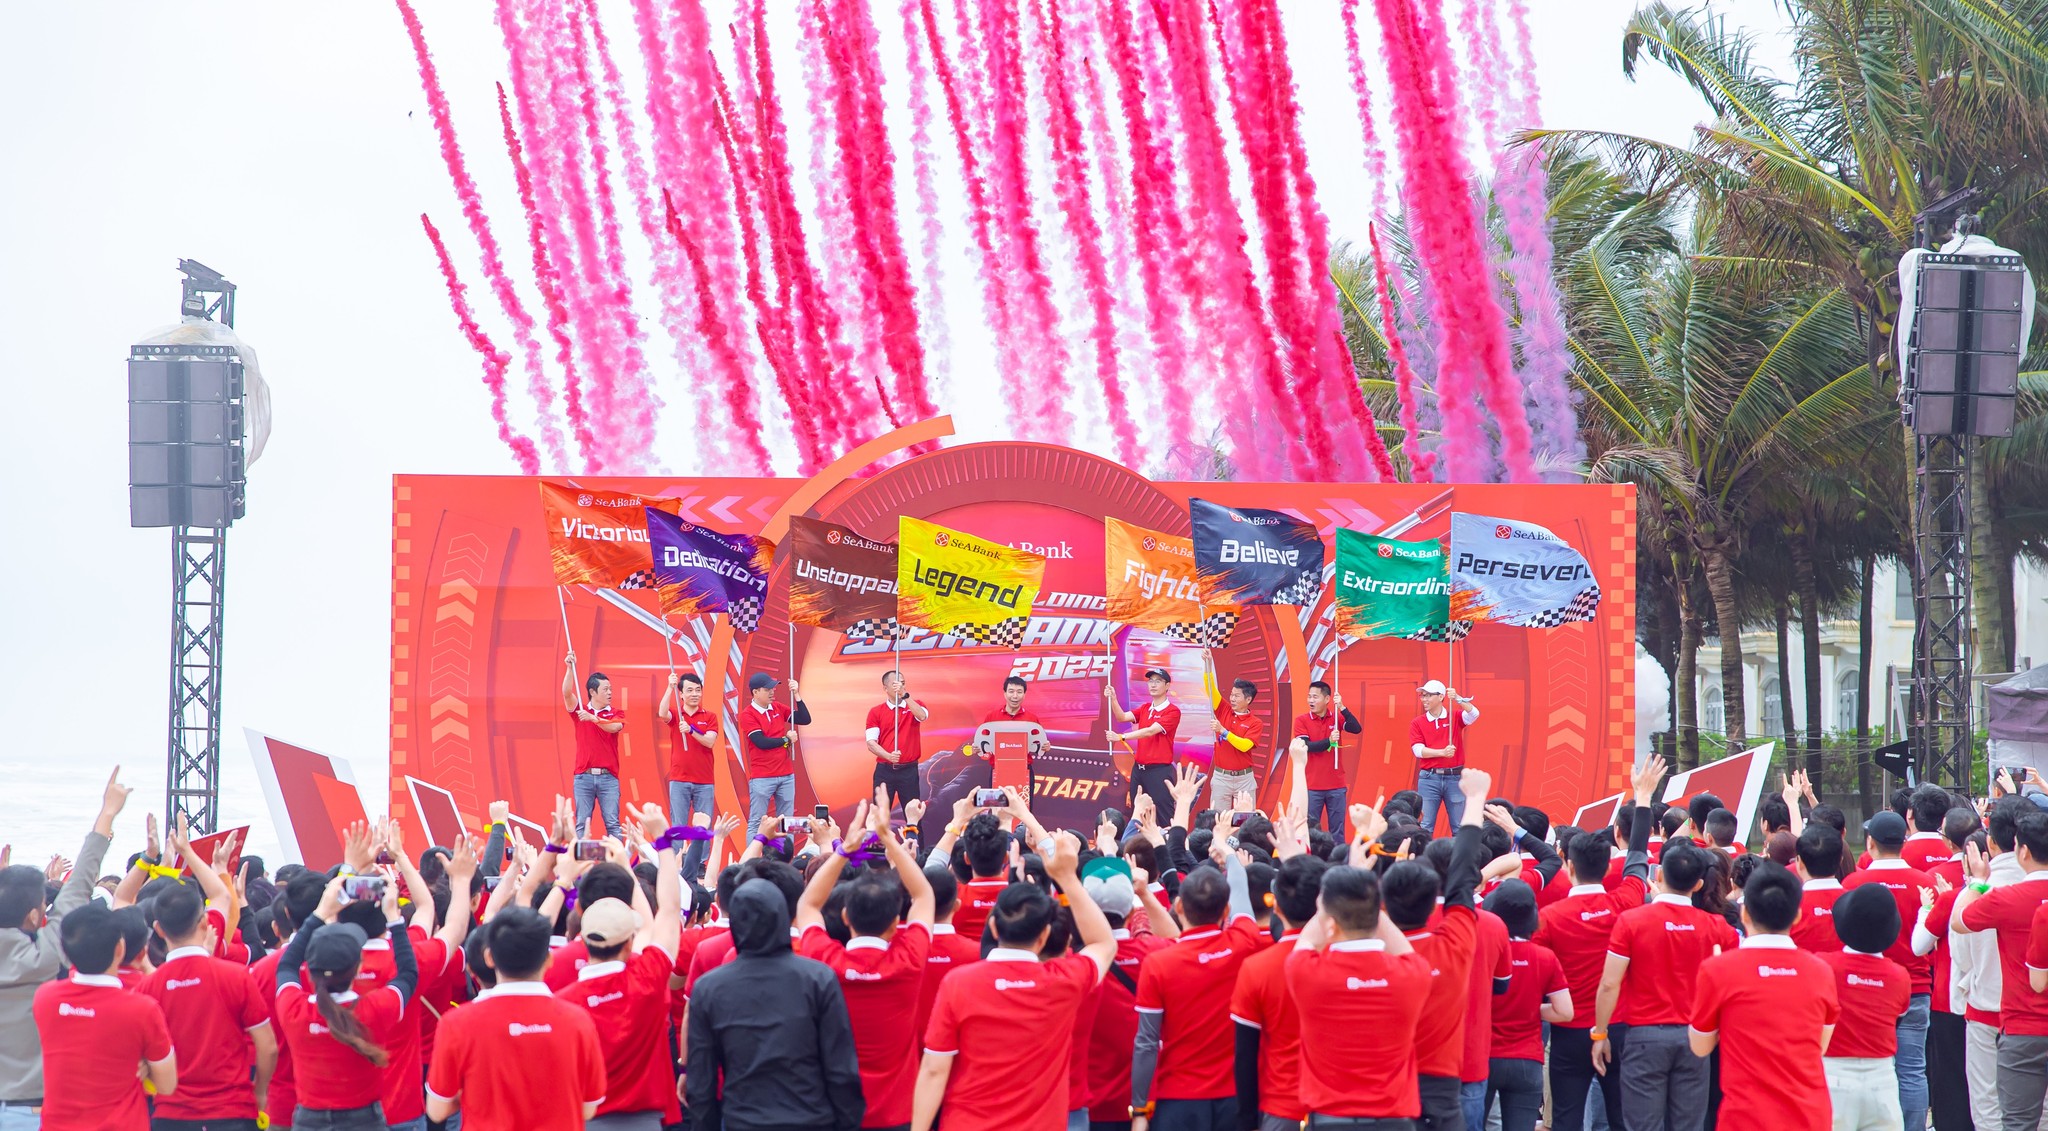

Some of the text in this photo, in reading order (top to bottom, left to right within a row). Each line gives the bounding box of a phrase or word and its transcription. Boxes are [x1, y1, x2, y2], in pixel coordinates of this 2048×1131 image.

[842, 535, 895, 554] SeABank
[951, 538, 1001, 560] SeABank
[1157, 541, 1195, 558] SeABa
[1220, 539, 1299, 567] Believe
[664, 546, 767, 592] Dedication
[914, 558, 1024, 608] Legend
[1009, 655, 1117, 682] 2025
[1034, 775, 1110, 801] START
